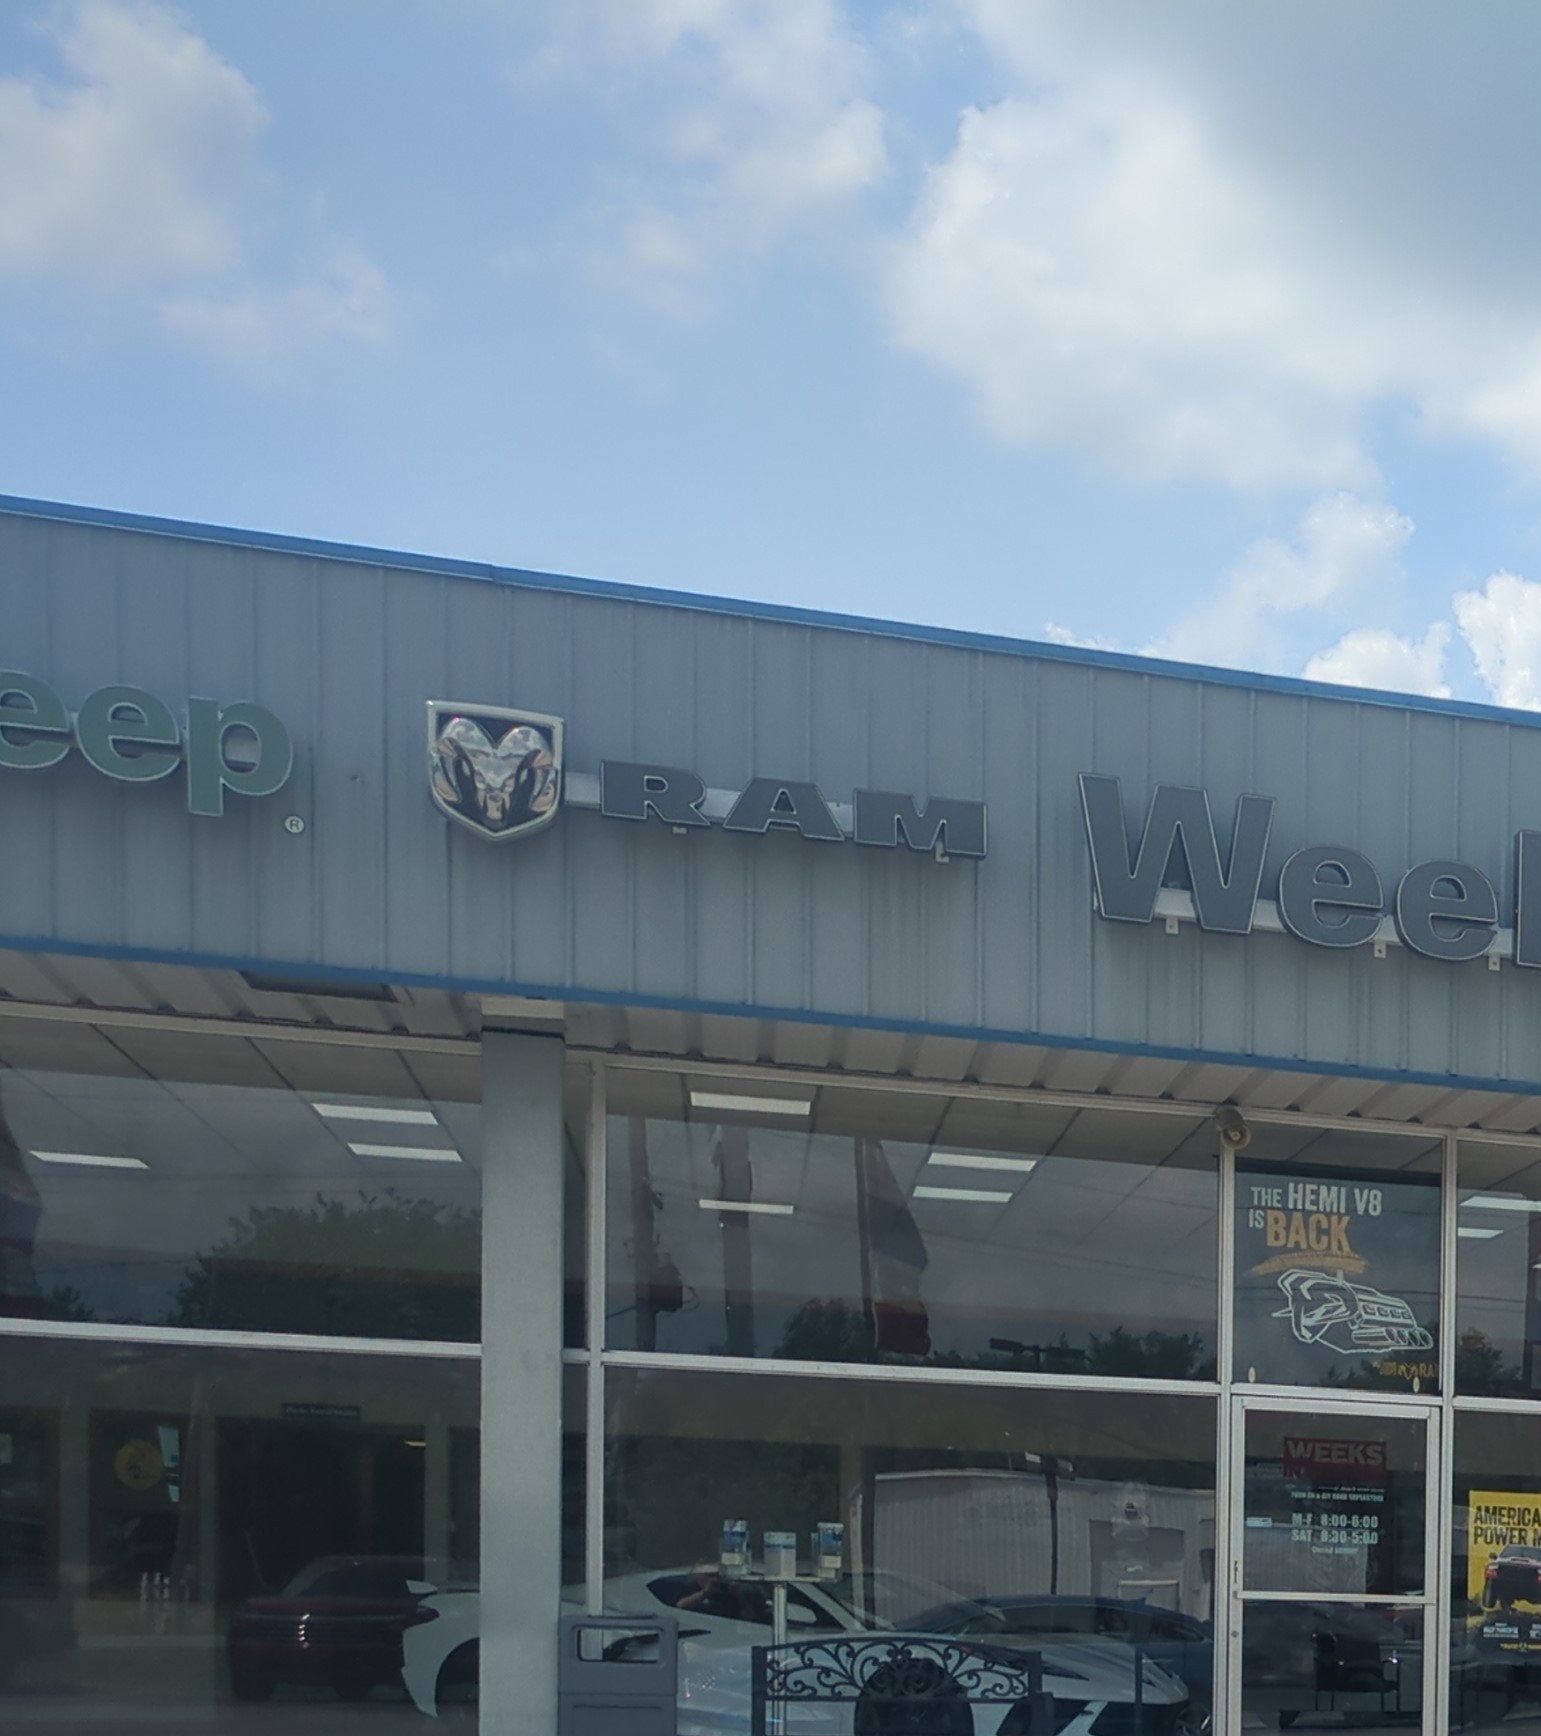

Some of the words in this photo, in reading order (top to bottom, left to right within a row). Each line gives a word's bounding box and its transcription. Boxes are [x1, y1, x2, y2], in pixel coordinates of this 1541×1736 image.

[0, 669, 293, 816] eep
[602, 760, 987, 857] RAM
[1250, 1187, 1282, 1207] THE
[1288, 1182, 1346, 1214] HEMI
[1354, 1188, 1382, 1216] V8
[1249, 1209, 1265, 1229] IS
[1266, 1209, 1350, 1254] BACK
[1286, 1441, 1384, 1465] WEEKS
[1292, 1513, 1313, 1525] M-F
[1291, 1530, 1313, 1541] SAT
[1474, 1526, 1527, 1545] POWER
